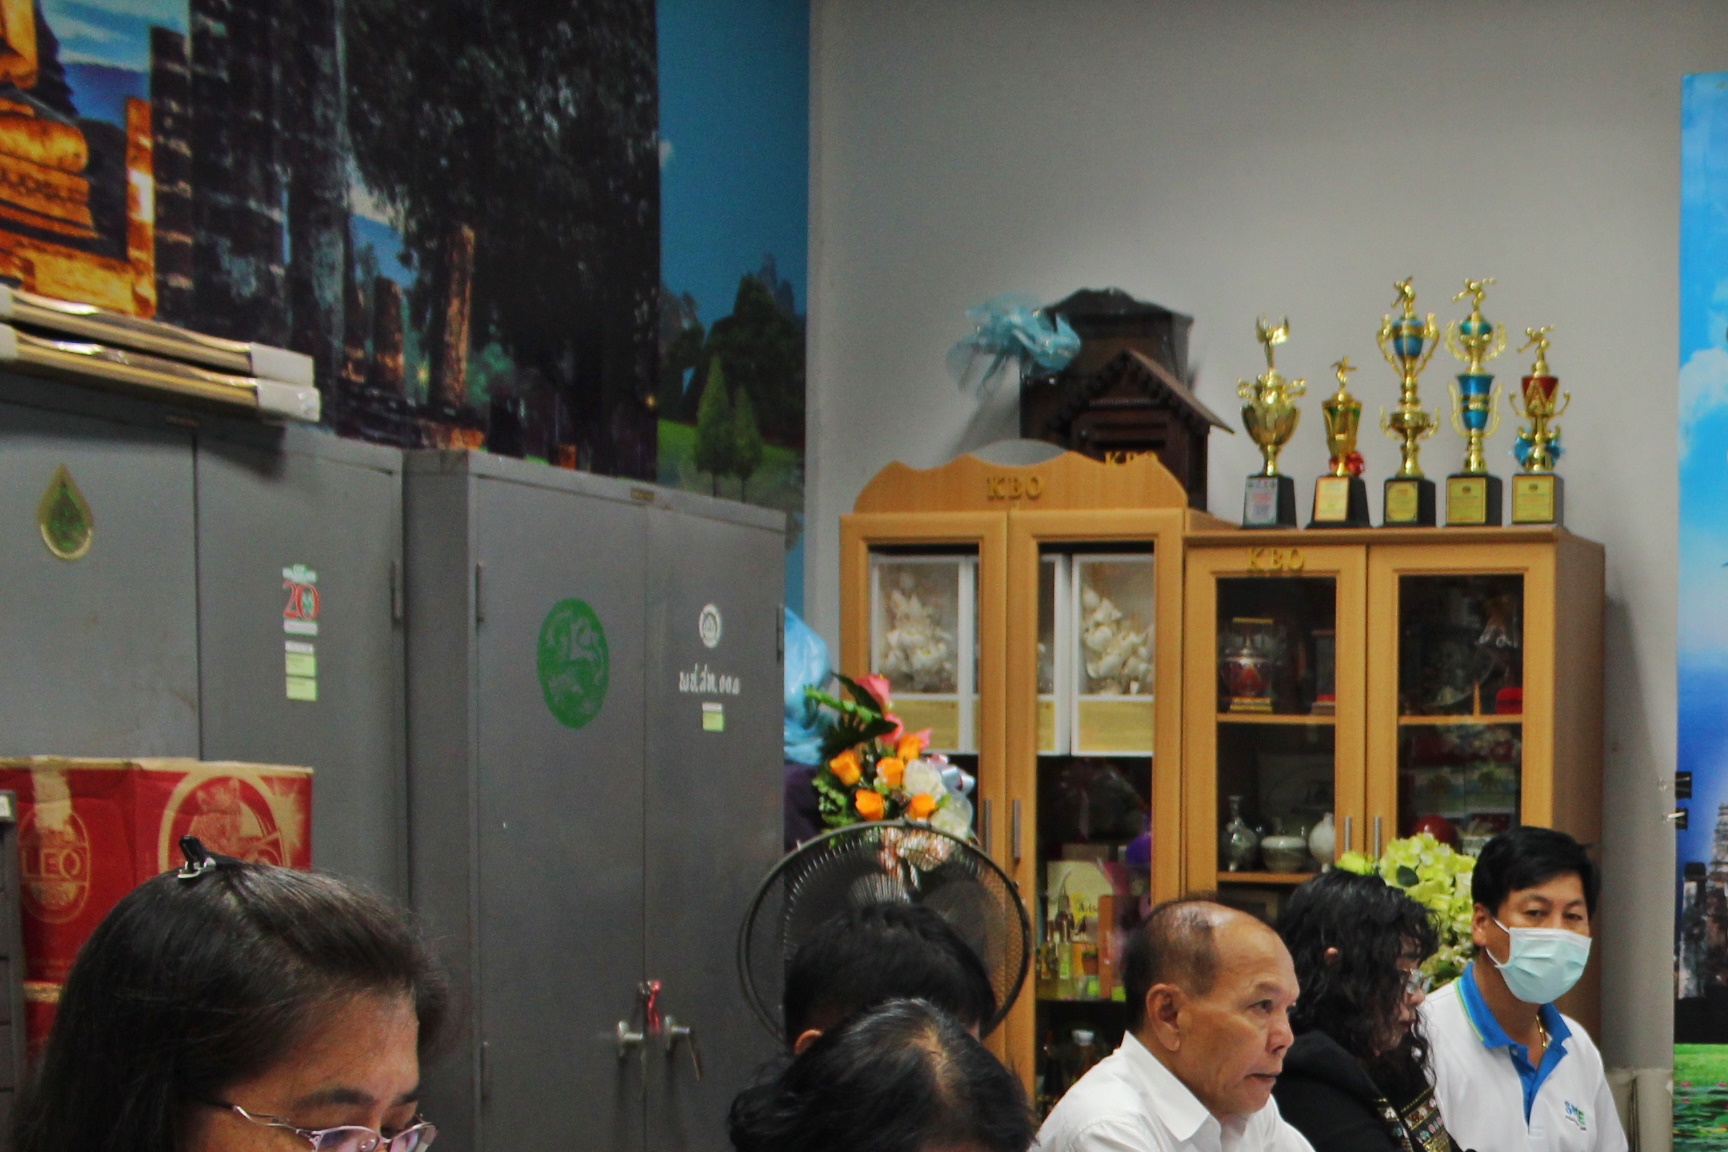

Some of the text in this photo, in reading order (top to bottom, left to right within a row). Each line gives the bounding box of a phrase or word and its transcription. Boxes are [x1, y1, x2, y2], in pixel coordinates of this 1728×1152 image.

[986, 475, 1044, 500] KBO
[1249, 547, 1305, 572] KBO
[21, 848, 82, 880] LEO
